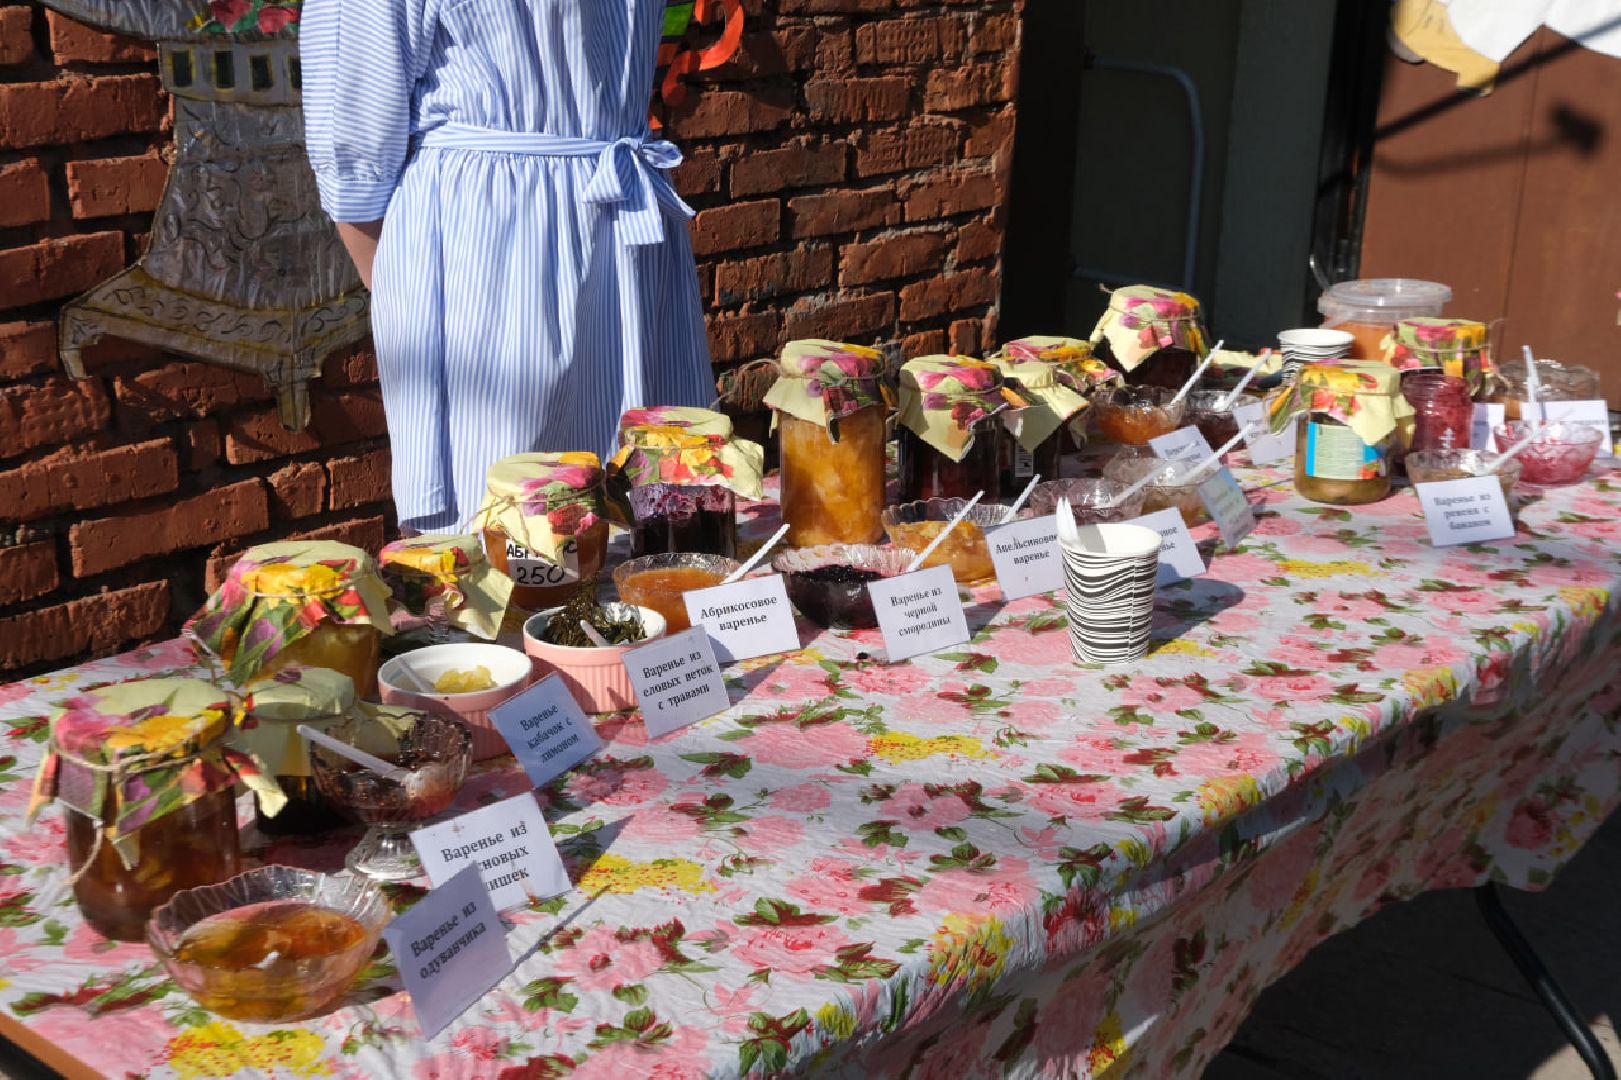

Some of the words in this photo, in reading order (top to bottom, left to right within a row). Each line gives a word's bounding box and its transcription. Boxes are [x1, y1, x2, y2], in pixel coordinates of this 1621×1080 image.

[1013, 551, 1050, 565] варенье
[517, 564, 565, 585] 250
[700, 596, 778, 619] Абрикосовое
[890, 591, 929, 607] Варенье
[931, 587, 943, 597] из
[719, 613, 768, 631] варенье
[904, 602, 938, 620] черной
[899, 616, 952, 636] смородины
[642, 657, 686, 678] Варенье
[689, 651, 702, 663] из
[643, 677, 682, 697] еловых
[685, 664, 714, 682] веток
[658, 700, 664, 710] с
[668, 684, 710, 708] травами
[520, 704, 559, 731] Варенье
[527, 722, 564, 749] кабачок
[566, 717, 573, 726] с
[541, 734, 580, 763] лимоном
[441, 833, 504, 863] Варенье
[510, 823, 527, 839] из
[478, 846, 530, 871] новых
[487, 868, 530, 892] ишек
[410, 915, 459, 957] Варенье
[462, 901, 477, 918] из
[420, 922, 486, 979] одуванчика
